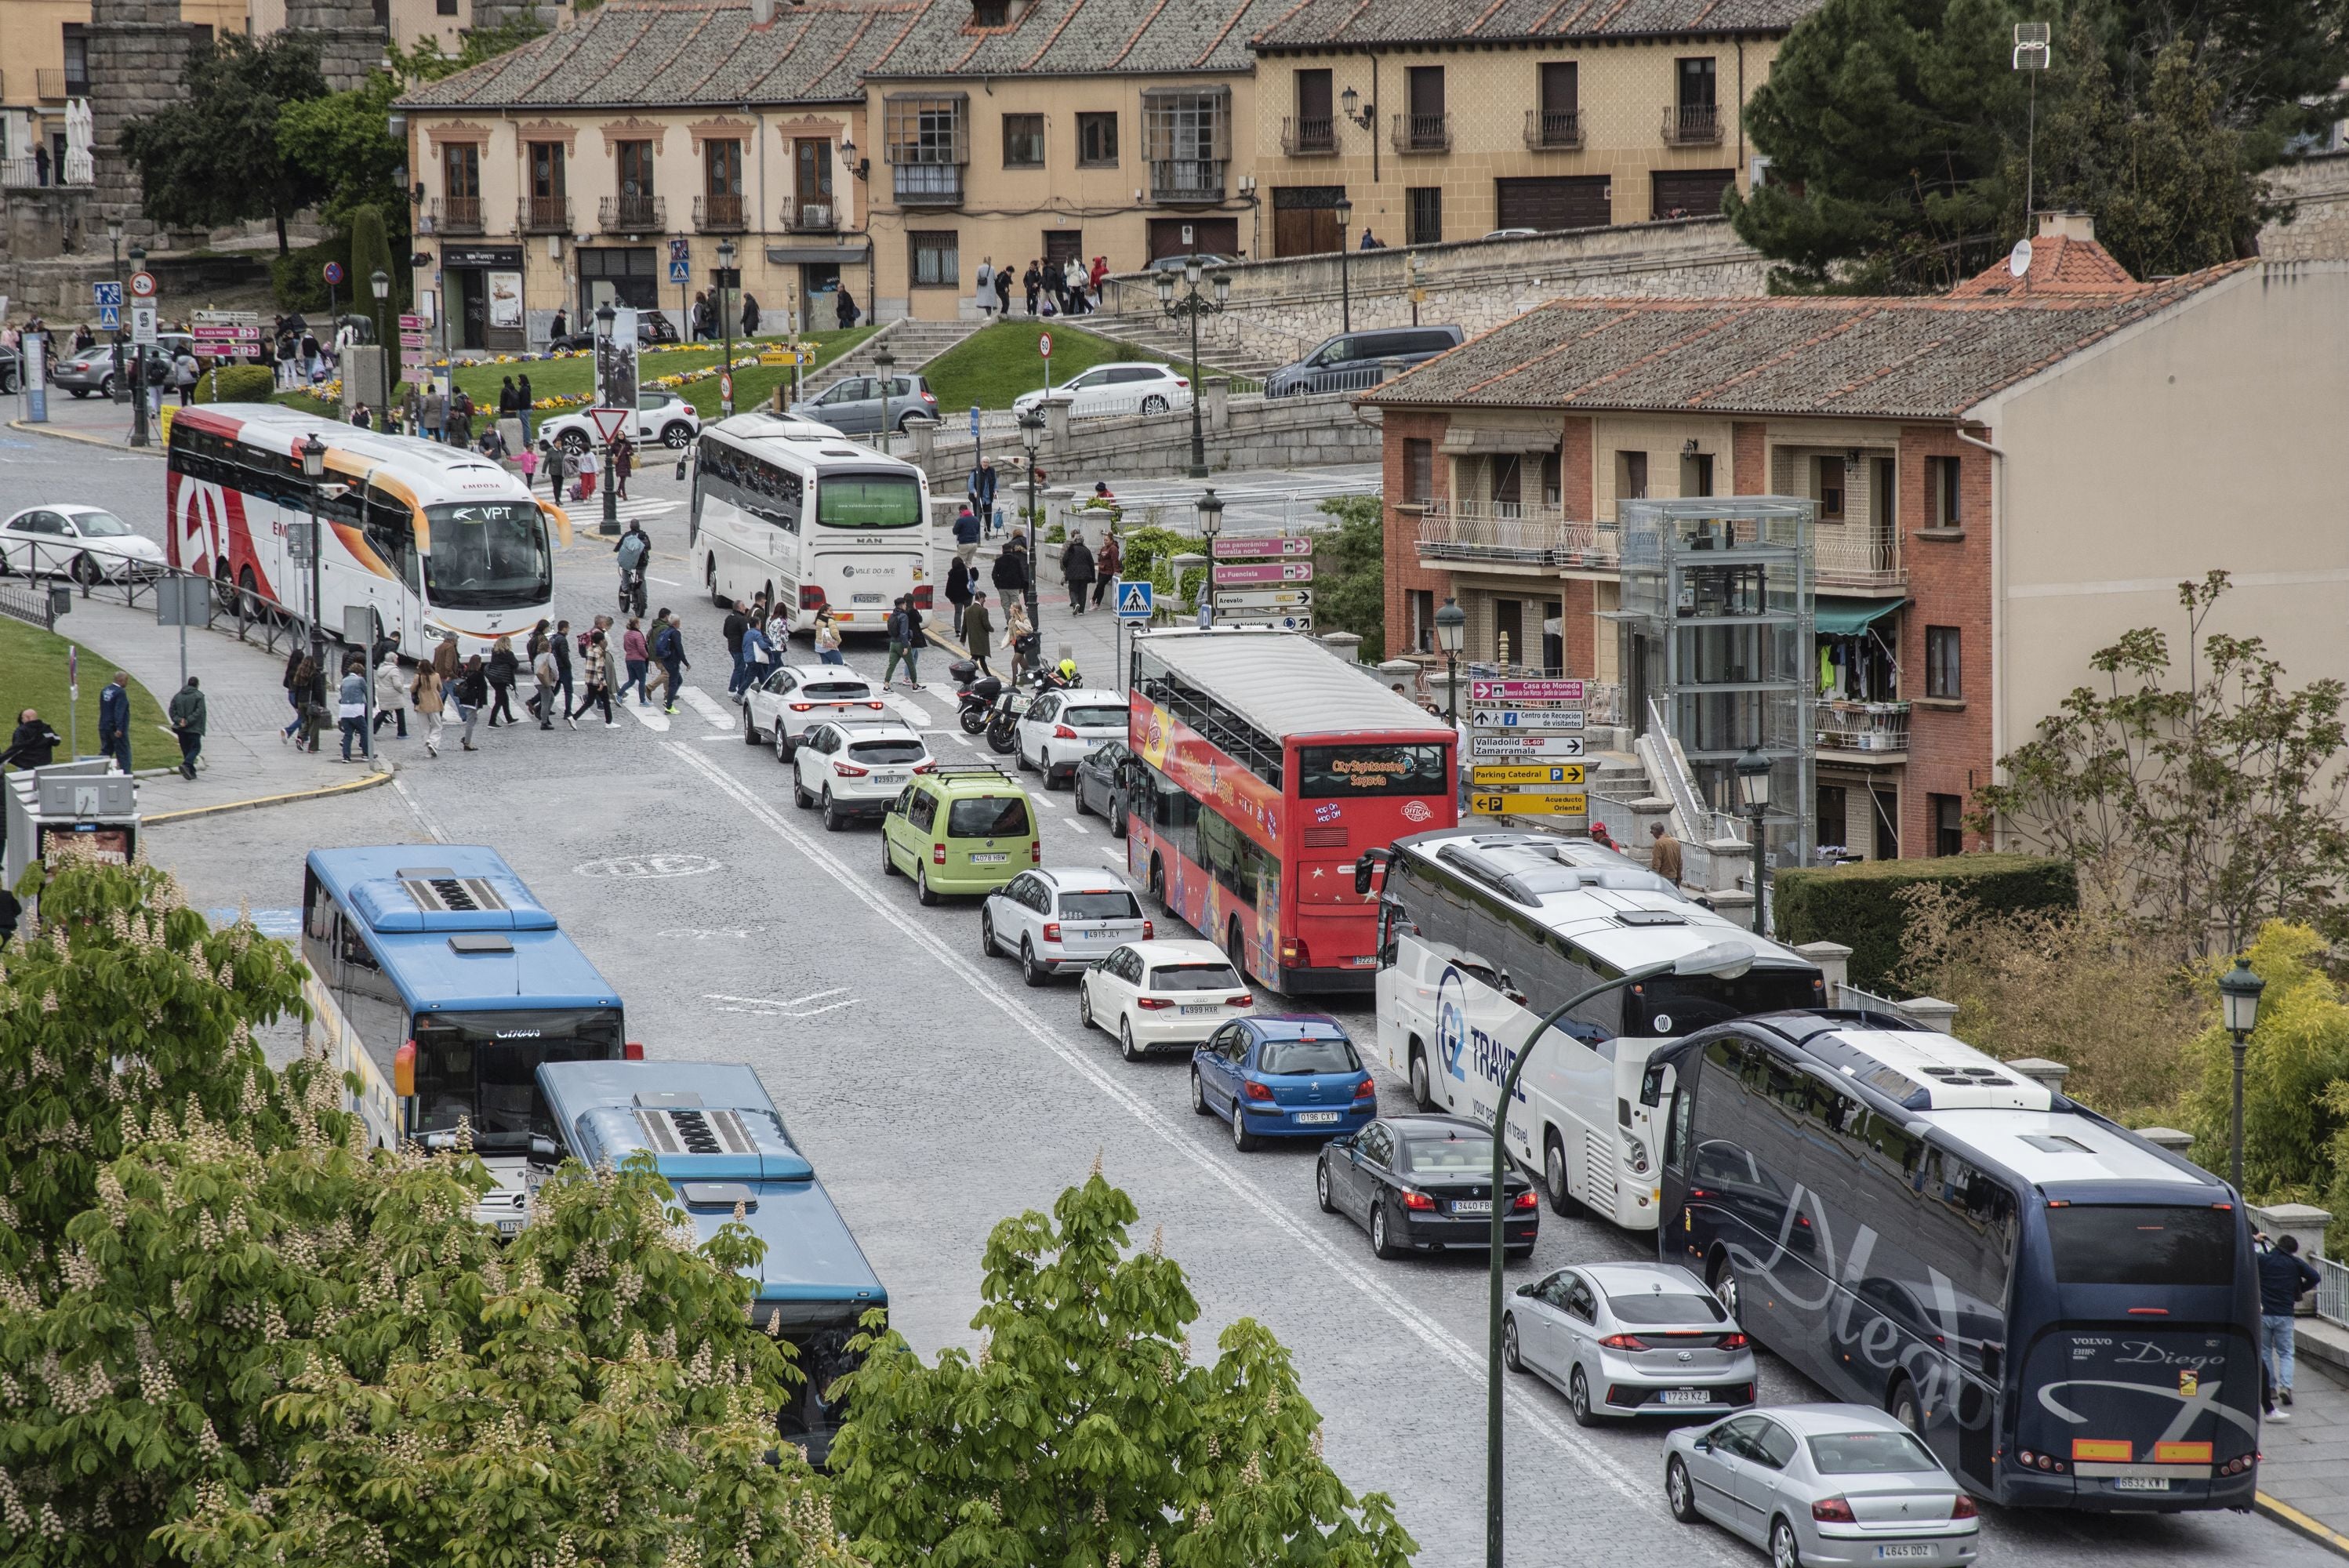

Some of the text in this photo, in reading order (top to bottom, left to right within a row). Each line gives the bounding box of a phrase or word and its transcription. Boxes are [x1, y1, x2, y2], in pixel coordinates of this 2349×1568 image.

[1041, 340, 1048, 350] 50
[481, 506, 512, 520] VPT
[1232, 541, 1269, 550] panorámica
[1551, 712, 1581, 721] Recepción
[1476, 738, 1520, 746] Valladolid
[1476, 746, 1536, 755] Zamarramala
[1476, 771, 1506, 779] Parking
[1552, 769, 1561, 780] P
[1350, 774, 1387, 788] Segovia
[1491, 798, 1500, 810] P
[1315, 806, 1328, 815] Hop
[1331, 809, 1341, 819] Off
[1404, 808, 1432, 818] OFFICIAL
[1358, 956, 1375, 964] 9223
[1657, 1016, 1668, 1030] 100
[1441, 1000, 1527, 1105] G2 TRAVEL
[1321, 1112, 1335, 1121] CXT
[1472, 1097, 1485, 1116] your
[1505, 1119, 1512, 1134] in
[1512, 1121, 1528, 1146] travel
[1458, 1202, 1478, 1210] 3440
[2114, 1341, 2226, 1370] Diego
[1668, 1391, 1708, 1400] 1723 KZJ
[2121, 1478, 2166, 1488] 6632 KWT
[1885, 1546, 1908, 1556] 4645
